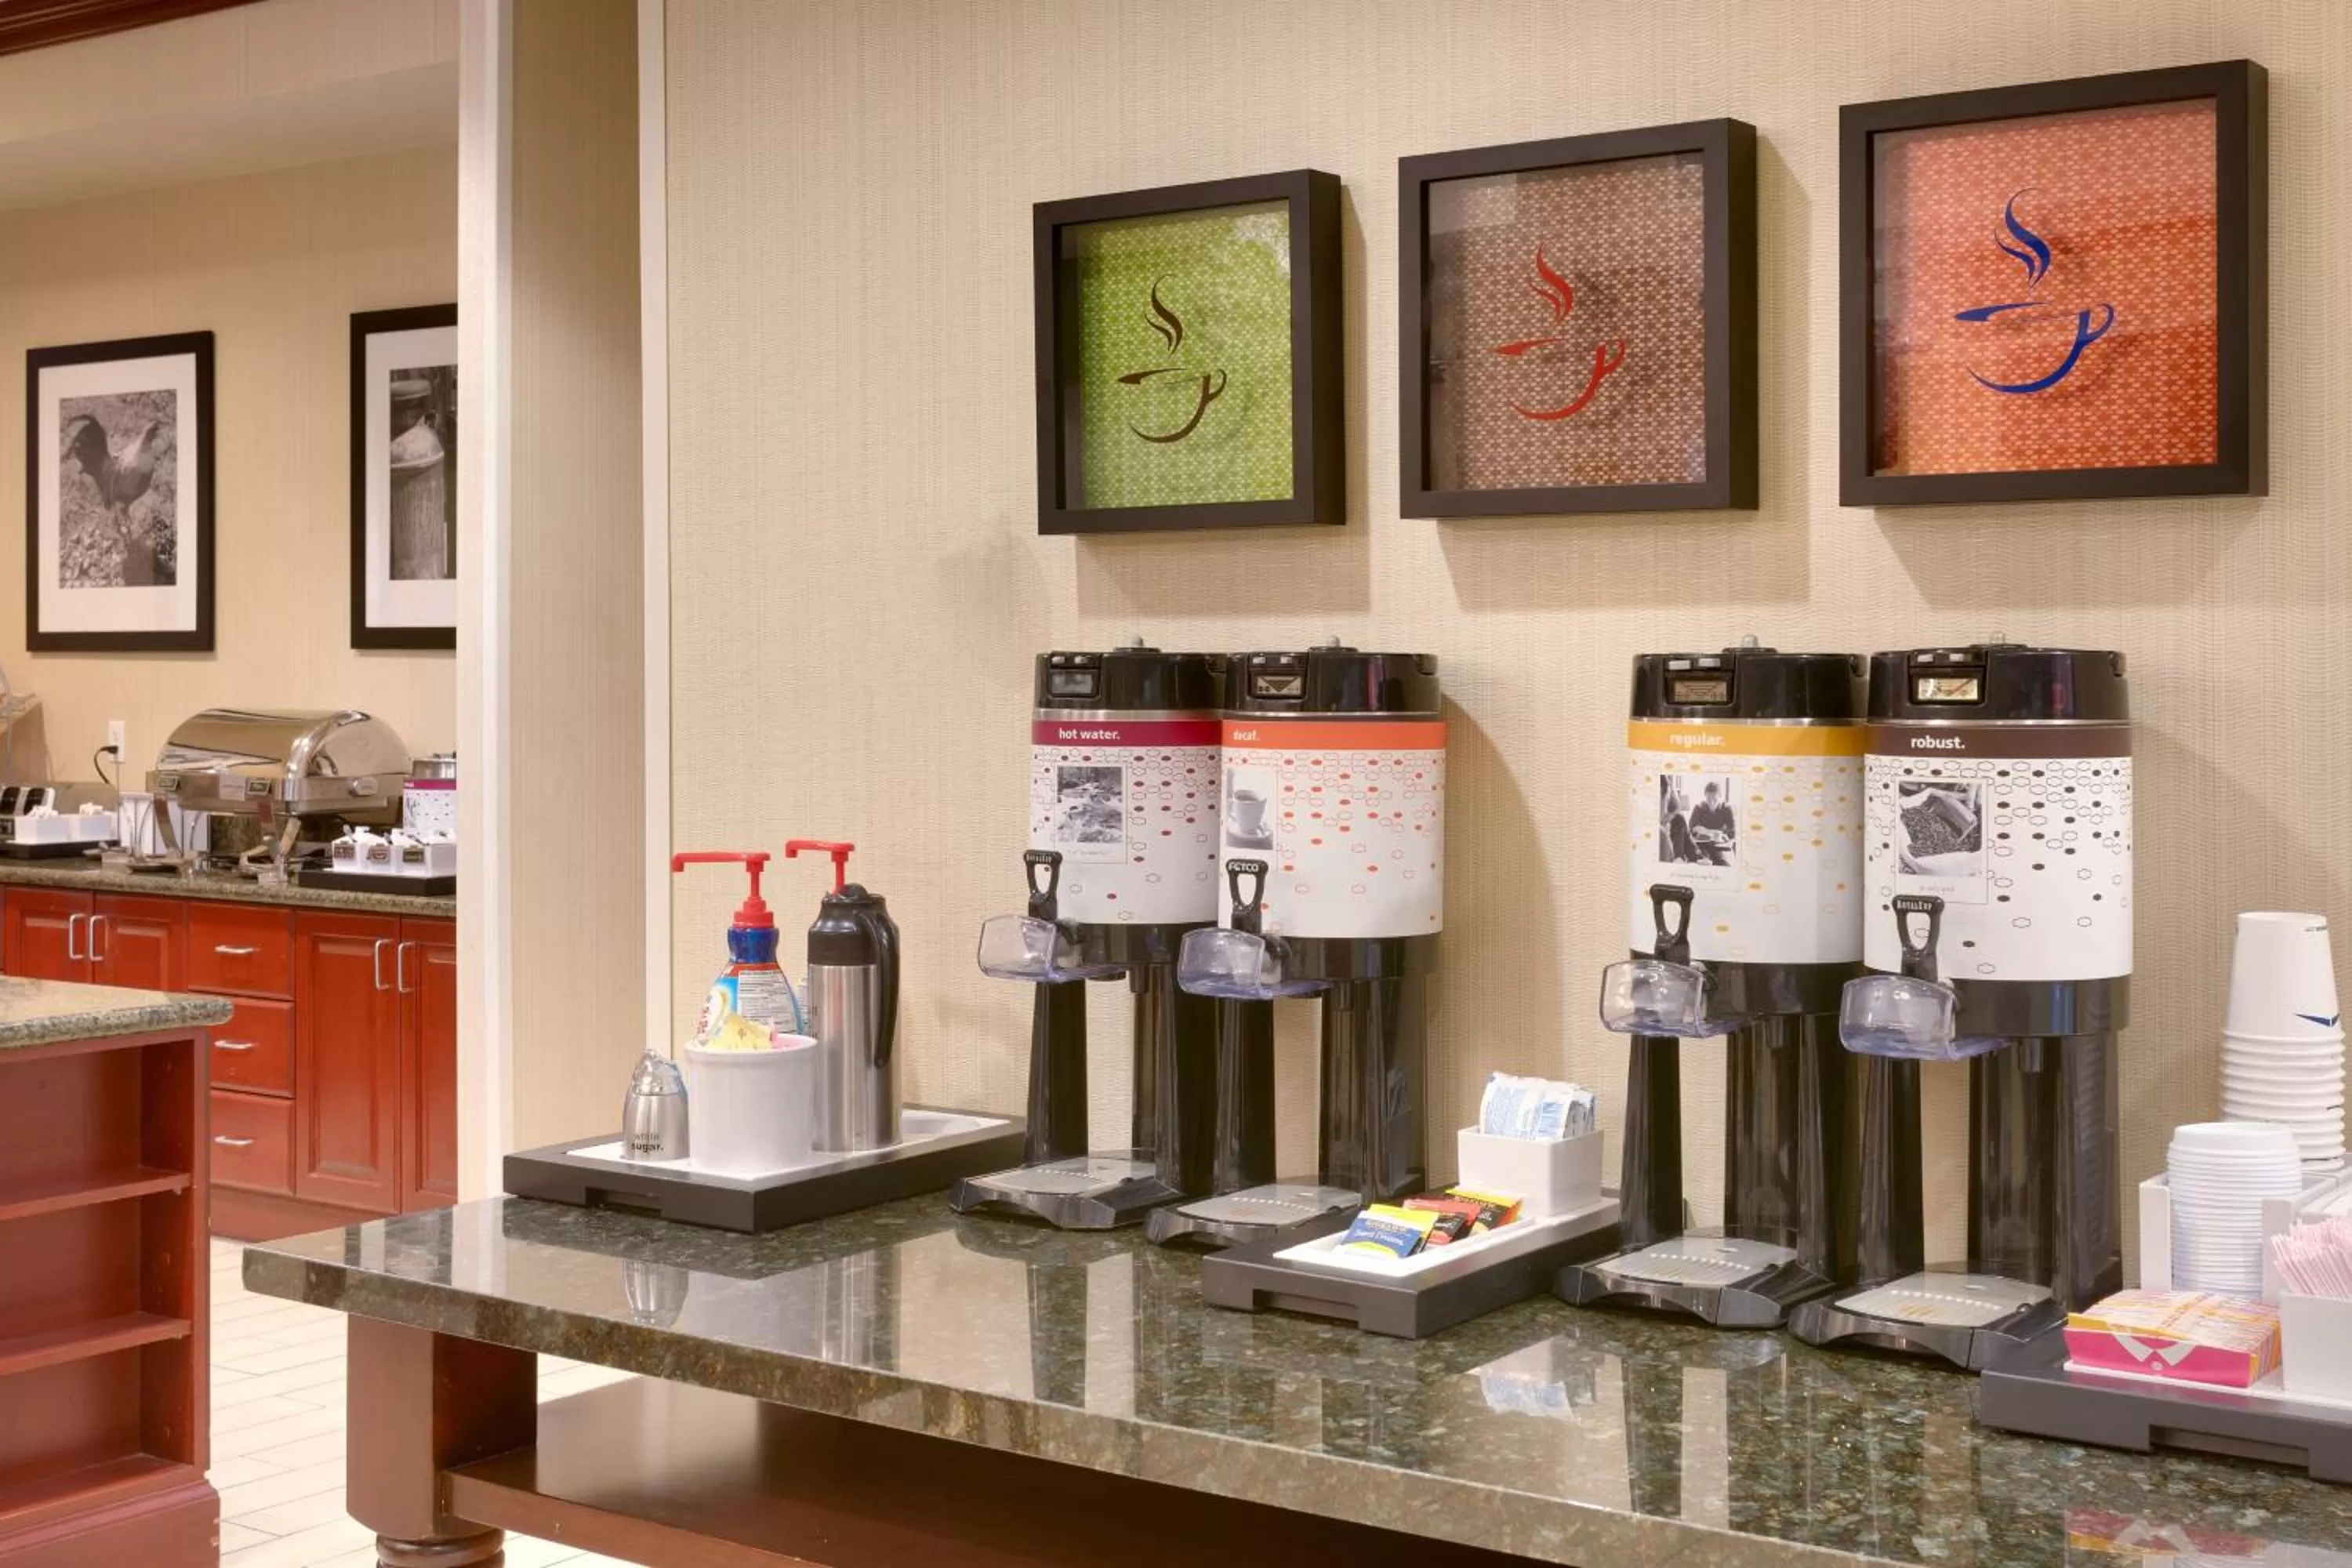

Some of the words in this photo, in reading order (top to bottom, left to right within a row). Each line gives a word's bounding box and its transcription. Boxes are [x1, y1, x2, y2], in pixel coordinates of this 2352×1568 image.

[1059, 727, 1078, 740] hot
[1080, 728, 1121, 741] water.
[1669, 731, 1726, 749] regular.
[1911, 735, 1965, 749] robust.
[630, 1142, 664, 1153] sugar.
